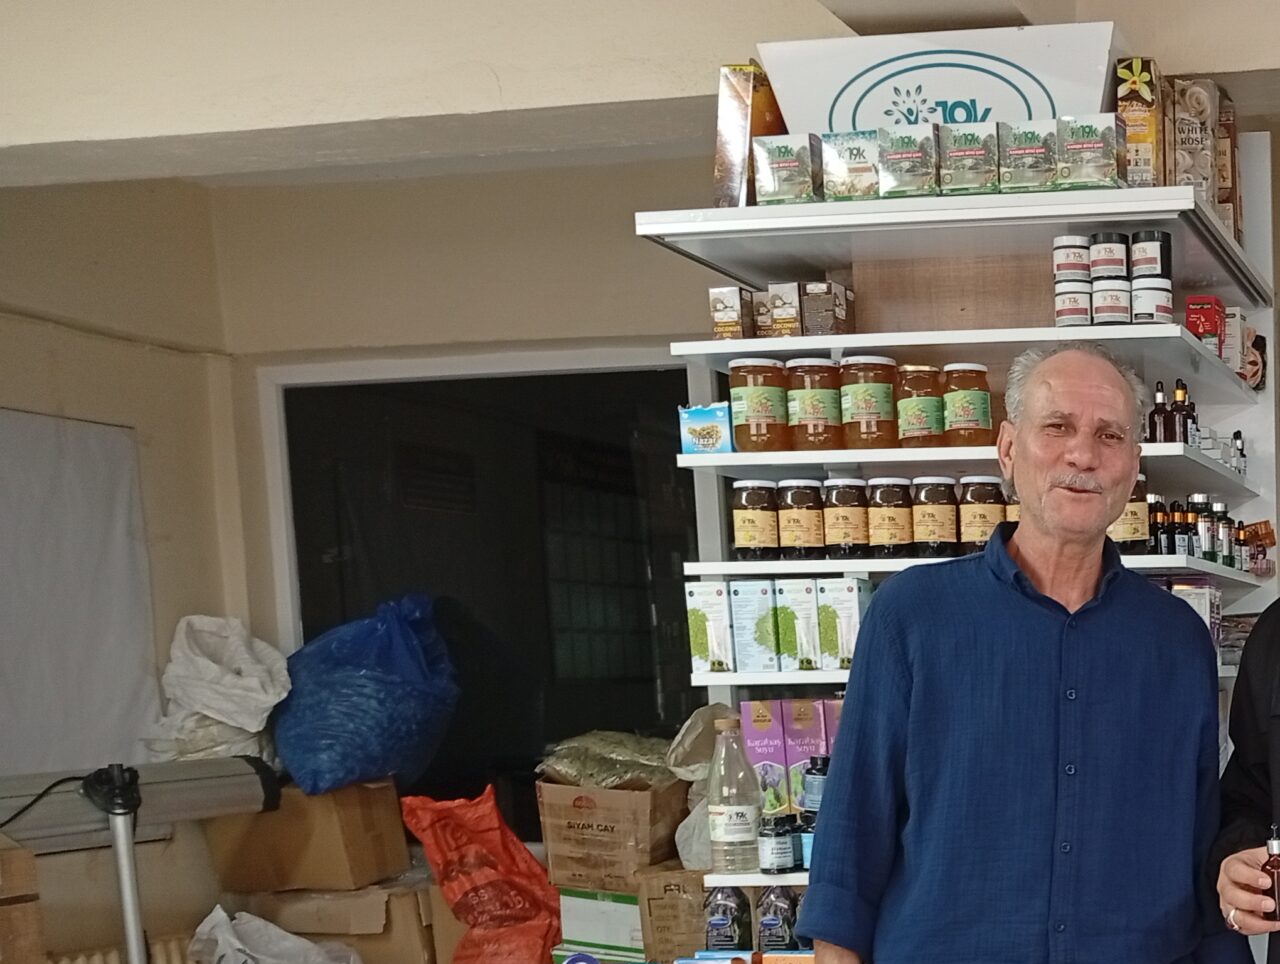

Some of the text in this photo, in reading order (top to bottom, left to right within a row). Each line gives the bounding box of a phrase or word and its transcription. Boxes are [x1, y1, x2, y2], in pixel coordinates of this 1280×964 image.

[1177, 125, 1209, 136] WHITE
[1180, 136, 1205, 146] ROSE
[773, 322, 799, 330] COCONUT
